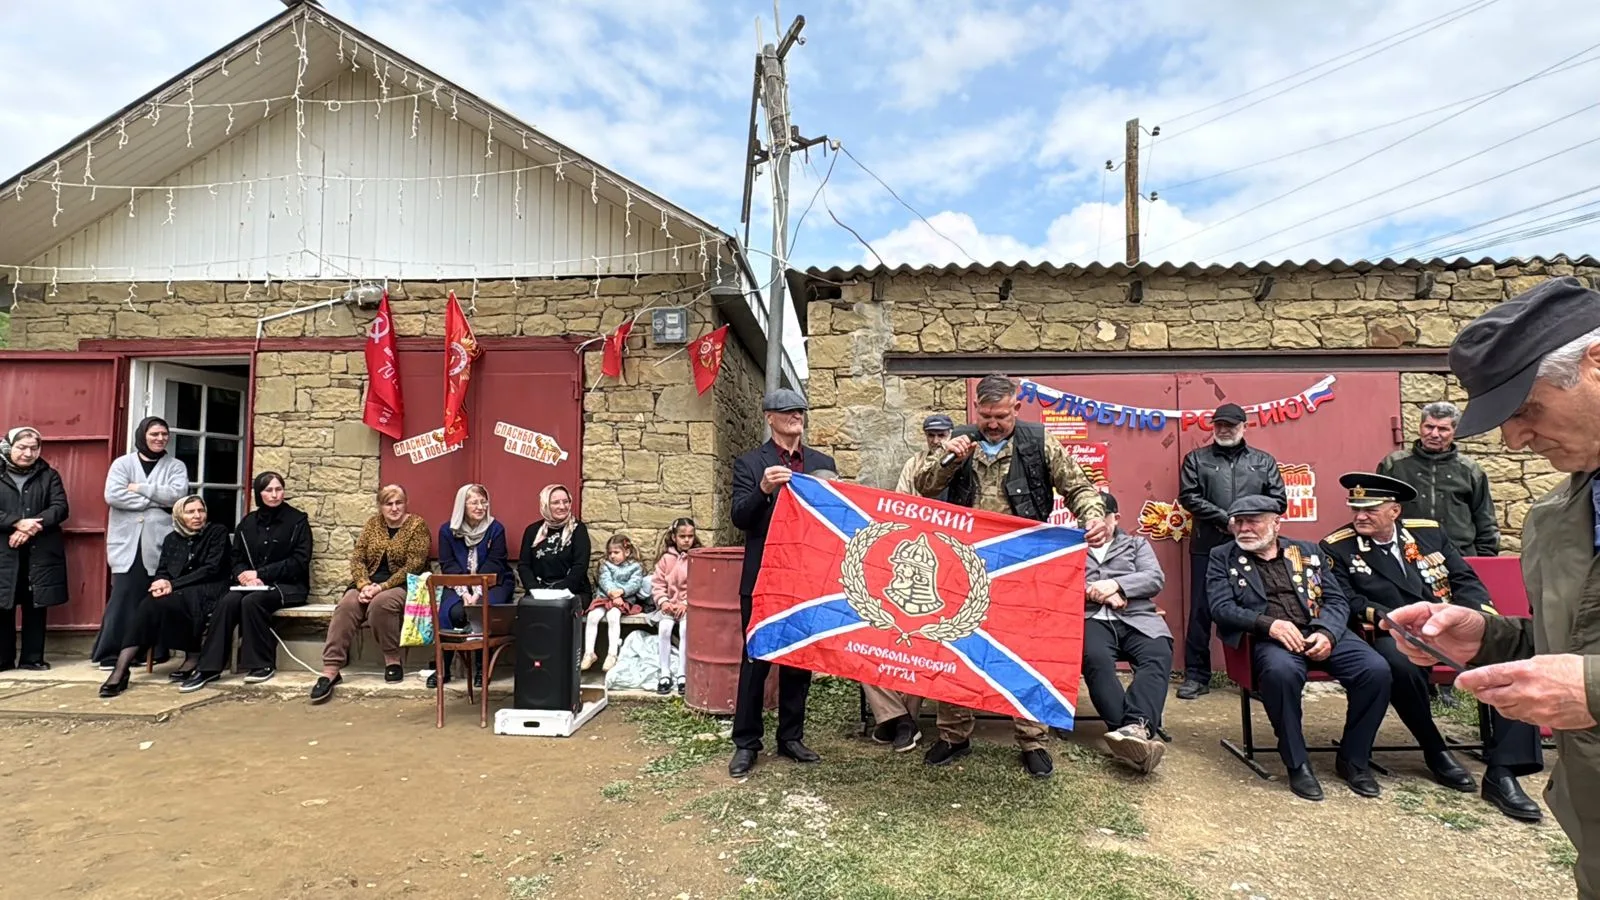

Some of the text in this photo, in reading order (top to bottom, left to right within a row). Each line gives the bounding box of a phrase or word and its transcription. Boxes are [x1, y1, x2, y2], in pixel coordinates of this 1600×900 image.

[1016, 382, 1037, 403] Я
[1055, 394, 1167, 431] ЛЮБЛЮ
[494, 423, 534, 444] СПАСИБО
[394, 434, 432, 456] СПАСИБО
[412, 449, 423, 462] ЗА
[506, 439, 517, 452] ЗА
[877, 497, 974, 533] НЕВСКИЙ
[844, 641, 957, 674] ДОБРОВОЛЬЧЕСКИЙ
